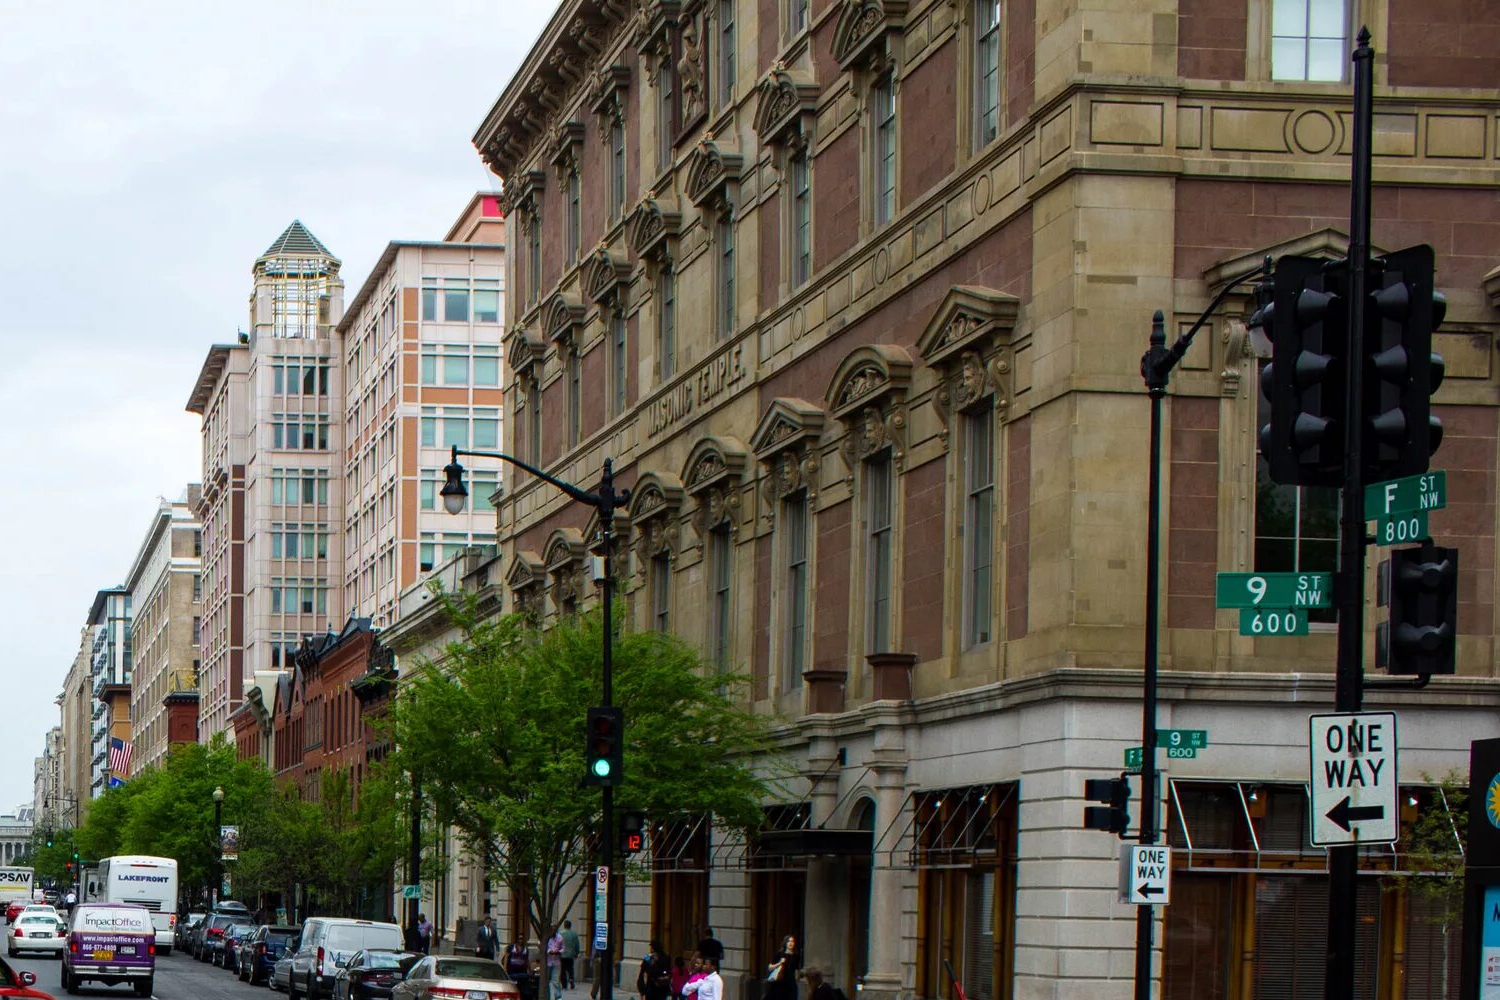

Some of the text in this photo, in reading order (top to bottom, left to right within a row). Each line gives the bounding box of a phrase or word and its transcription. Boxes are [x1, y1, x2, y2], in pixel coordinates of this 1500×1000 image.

[648, 384, 692, 439] MASONIC
[1384, 476, 1436, 514] F ST
[1420, 492, 1439, 509] NW
[1385, 518, 1420, 542] 800
[1247, 575, 1322, 605] 9 ST
[1295, 590, 1322, 606] NW
[1251, 612, 1297, 633] 600
[1170, 731, 1181, 746] 9
[1326, 723, 1383, 754] ONE
[1129, 750, 1135, 764] F
[1169, 747, 1193, 758] 600
[1324, 758, 1385, 788] WAY
[628, 835, 640, 849] 12
[1138, 849, 1165, 864] ONE
[0, 872, 31, 883] PSAV
[118, 874, 169, 884] LAKEFRONT
[1137, 866, 1166, 880] WAY
[83, 935, 145, 944] www.impactoffice.com
